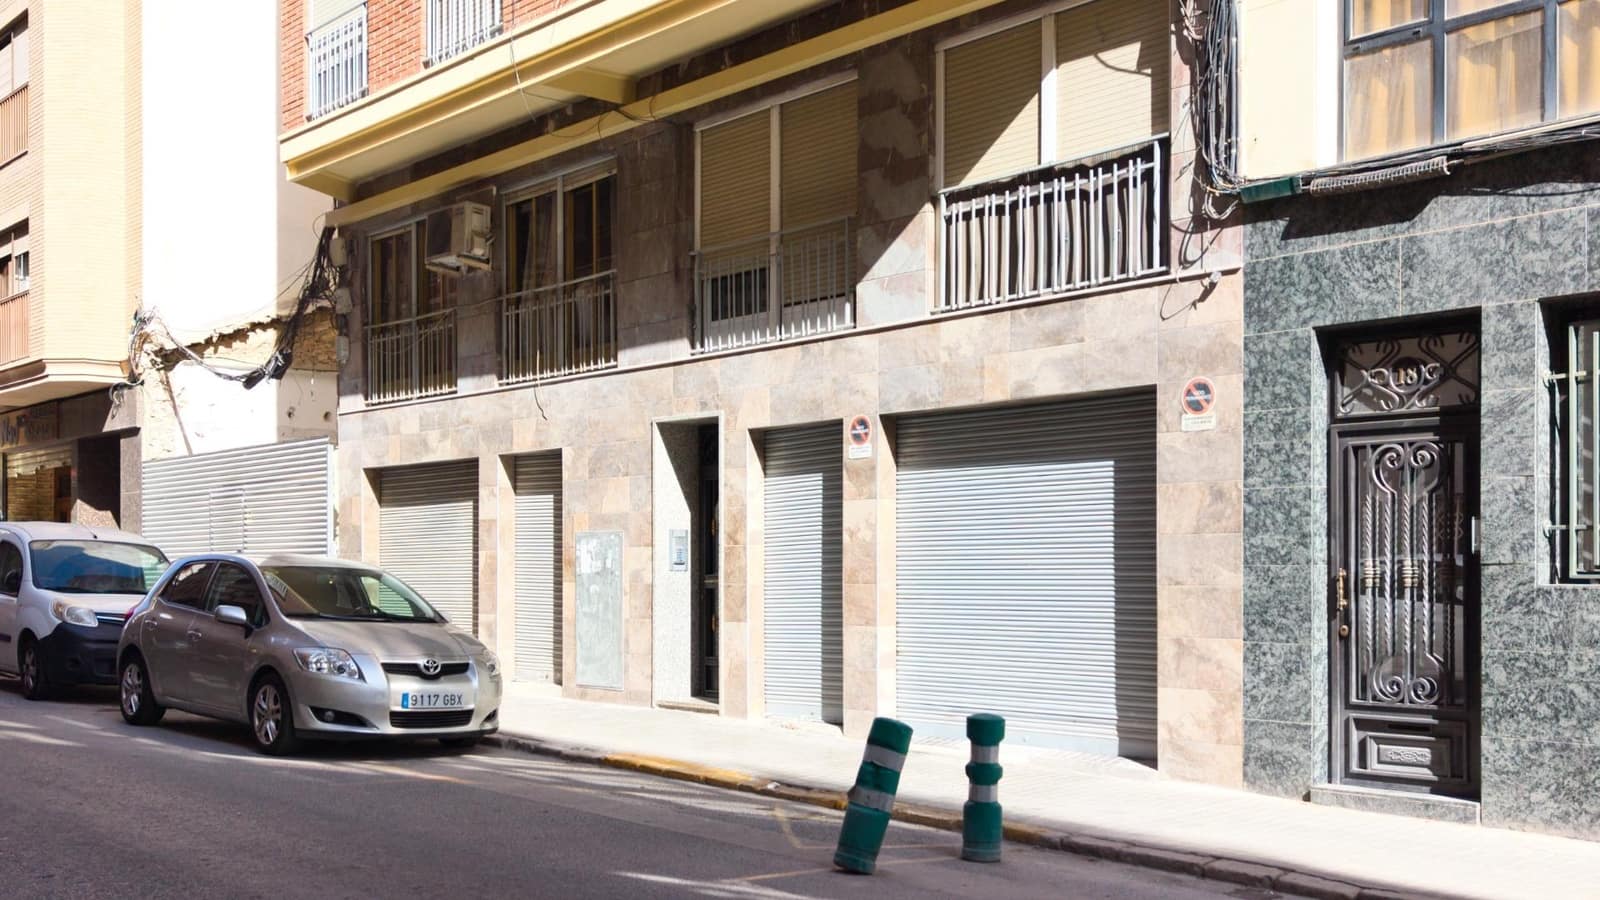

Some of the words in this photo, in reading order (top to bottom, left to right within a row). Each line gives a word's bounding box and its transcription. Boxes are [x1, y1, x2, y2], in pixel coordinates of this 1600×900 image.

[1396, 366, 1418, 385] 18
[410, 694, 440, 706] 9117
[443, 694, 463, 706] GBX
